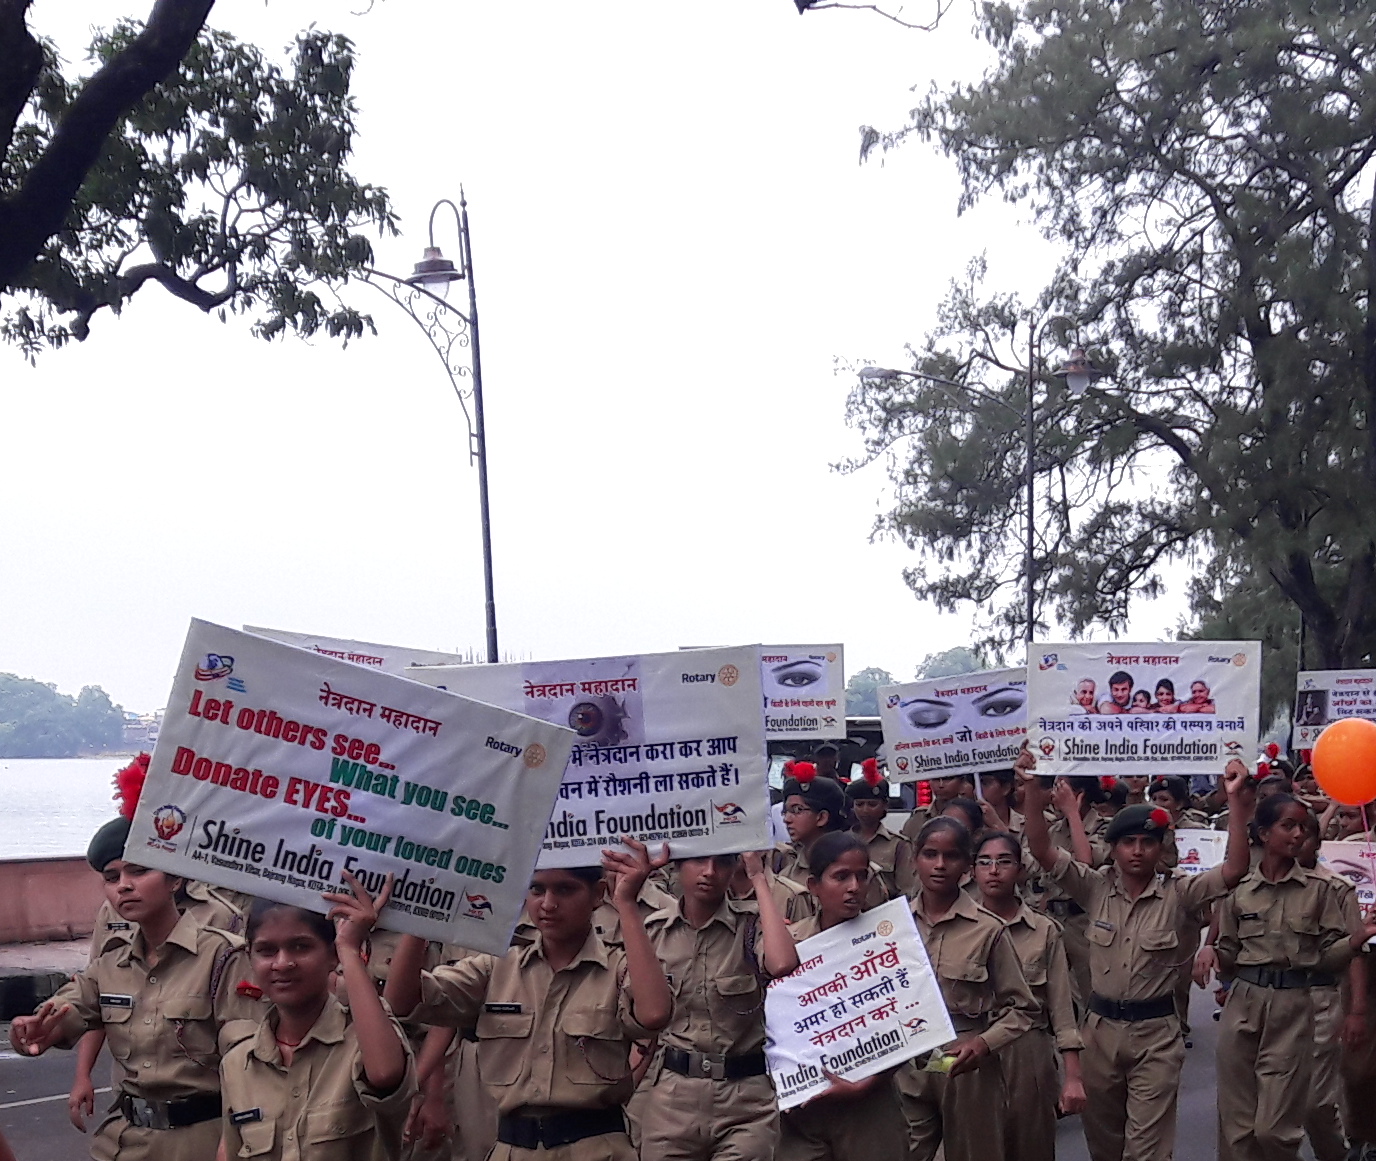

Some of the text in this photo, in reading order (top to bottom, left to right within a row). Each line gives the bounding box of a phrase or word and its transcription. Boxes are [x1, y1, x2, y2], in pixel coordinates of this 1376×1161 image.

[523, 677, 639, 699] नेत्रदान महादान
[681, 672, 716, 684] Rotary
[188, 689, 234, 725] Let
[237, 707, 328, 751] others
[319, 681, 443, 738] नेत्रदान महादान
[765, 713, 818, 727] Foundation
[1038, 716, 1074, 732] नेत्रदान
[1077, 717, 1092, 732] को
[1095, 716, 1123, 732] अपने
[1162, 717, 1177, 732] की
[485, 736, 523, 758] Rotary
[588, 742, 641, 766] नेत्रदान
[644, 742, 675, 762] करा
[679, 738, 702, 760] कर
[708, 735, 738, 755] आप
[914, 754, 942, 769] Shine
[944, 749, 970, 765] India
[971, 744, 1020, 761] Foundatio
[1064, 736, 1218, 755] Shine India Foundation
[171, 746, 280, 799] Donate
[329, 757, 400, 799] What
[401, 781, 449, 813] you
[585, 775, 602, 798] में
[602, 771, 651, 797] रौशनी
[655, 774, 675, 792] ला
[678, 767, 717, 791] सकते
[544, 810, 588, 839] ndia
[594, 802, 707, 836] Foundation
[198, 819, 266, 864] Shine
[272, 838, 335, 881] India
[311, 816, 507, 884] of your loved ones
[851, 930, 878, 947] Rotary
[797, 941, 901, 1007] आपकी आँखें
[794, 1008, 829, 1034] अमर
[829, 996, 847, 1019] हो
[848, 975, 896, 1009] सकती
[809, 1014, 868, 1048] नेत्रदान
[868, 996, 899, 1022] करें
[780, 1063, 819, 1090] India
[819, 1028, 901, 1071] Foundation
